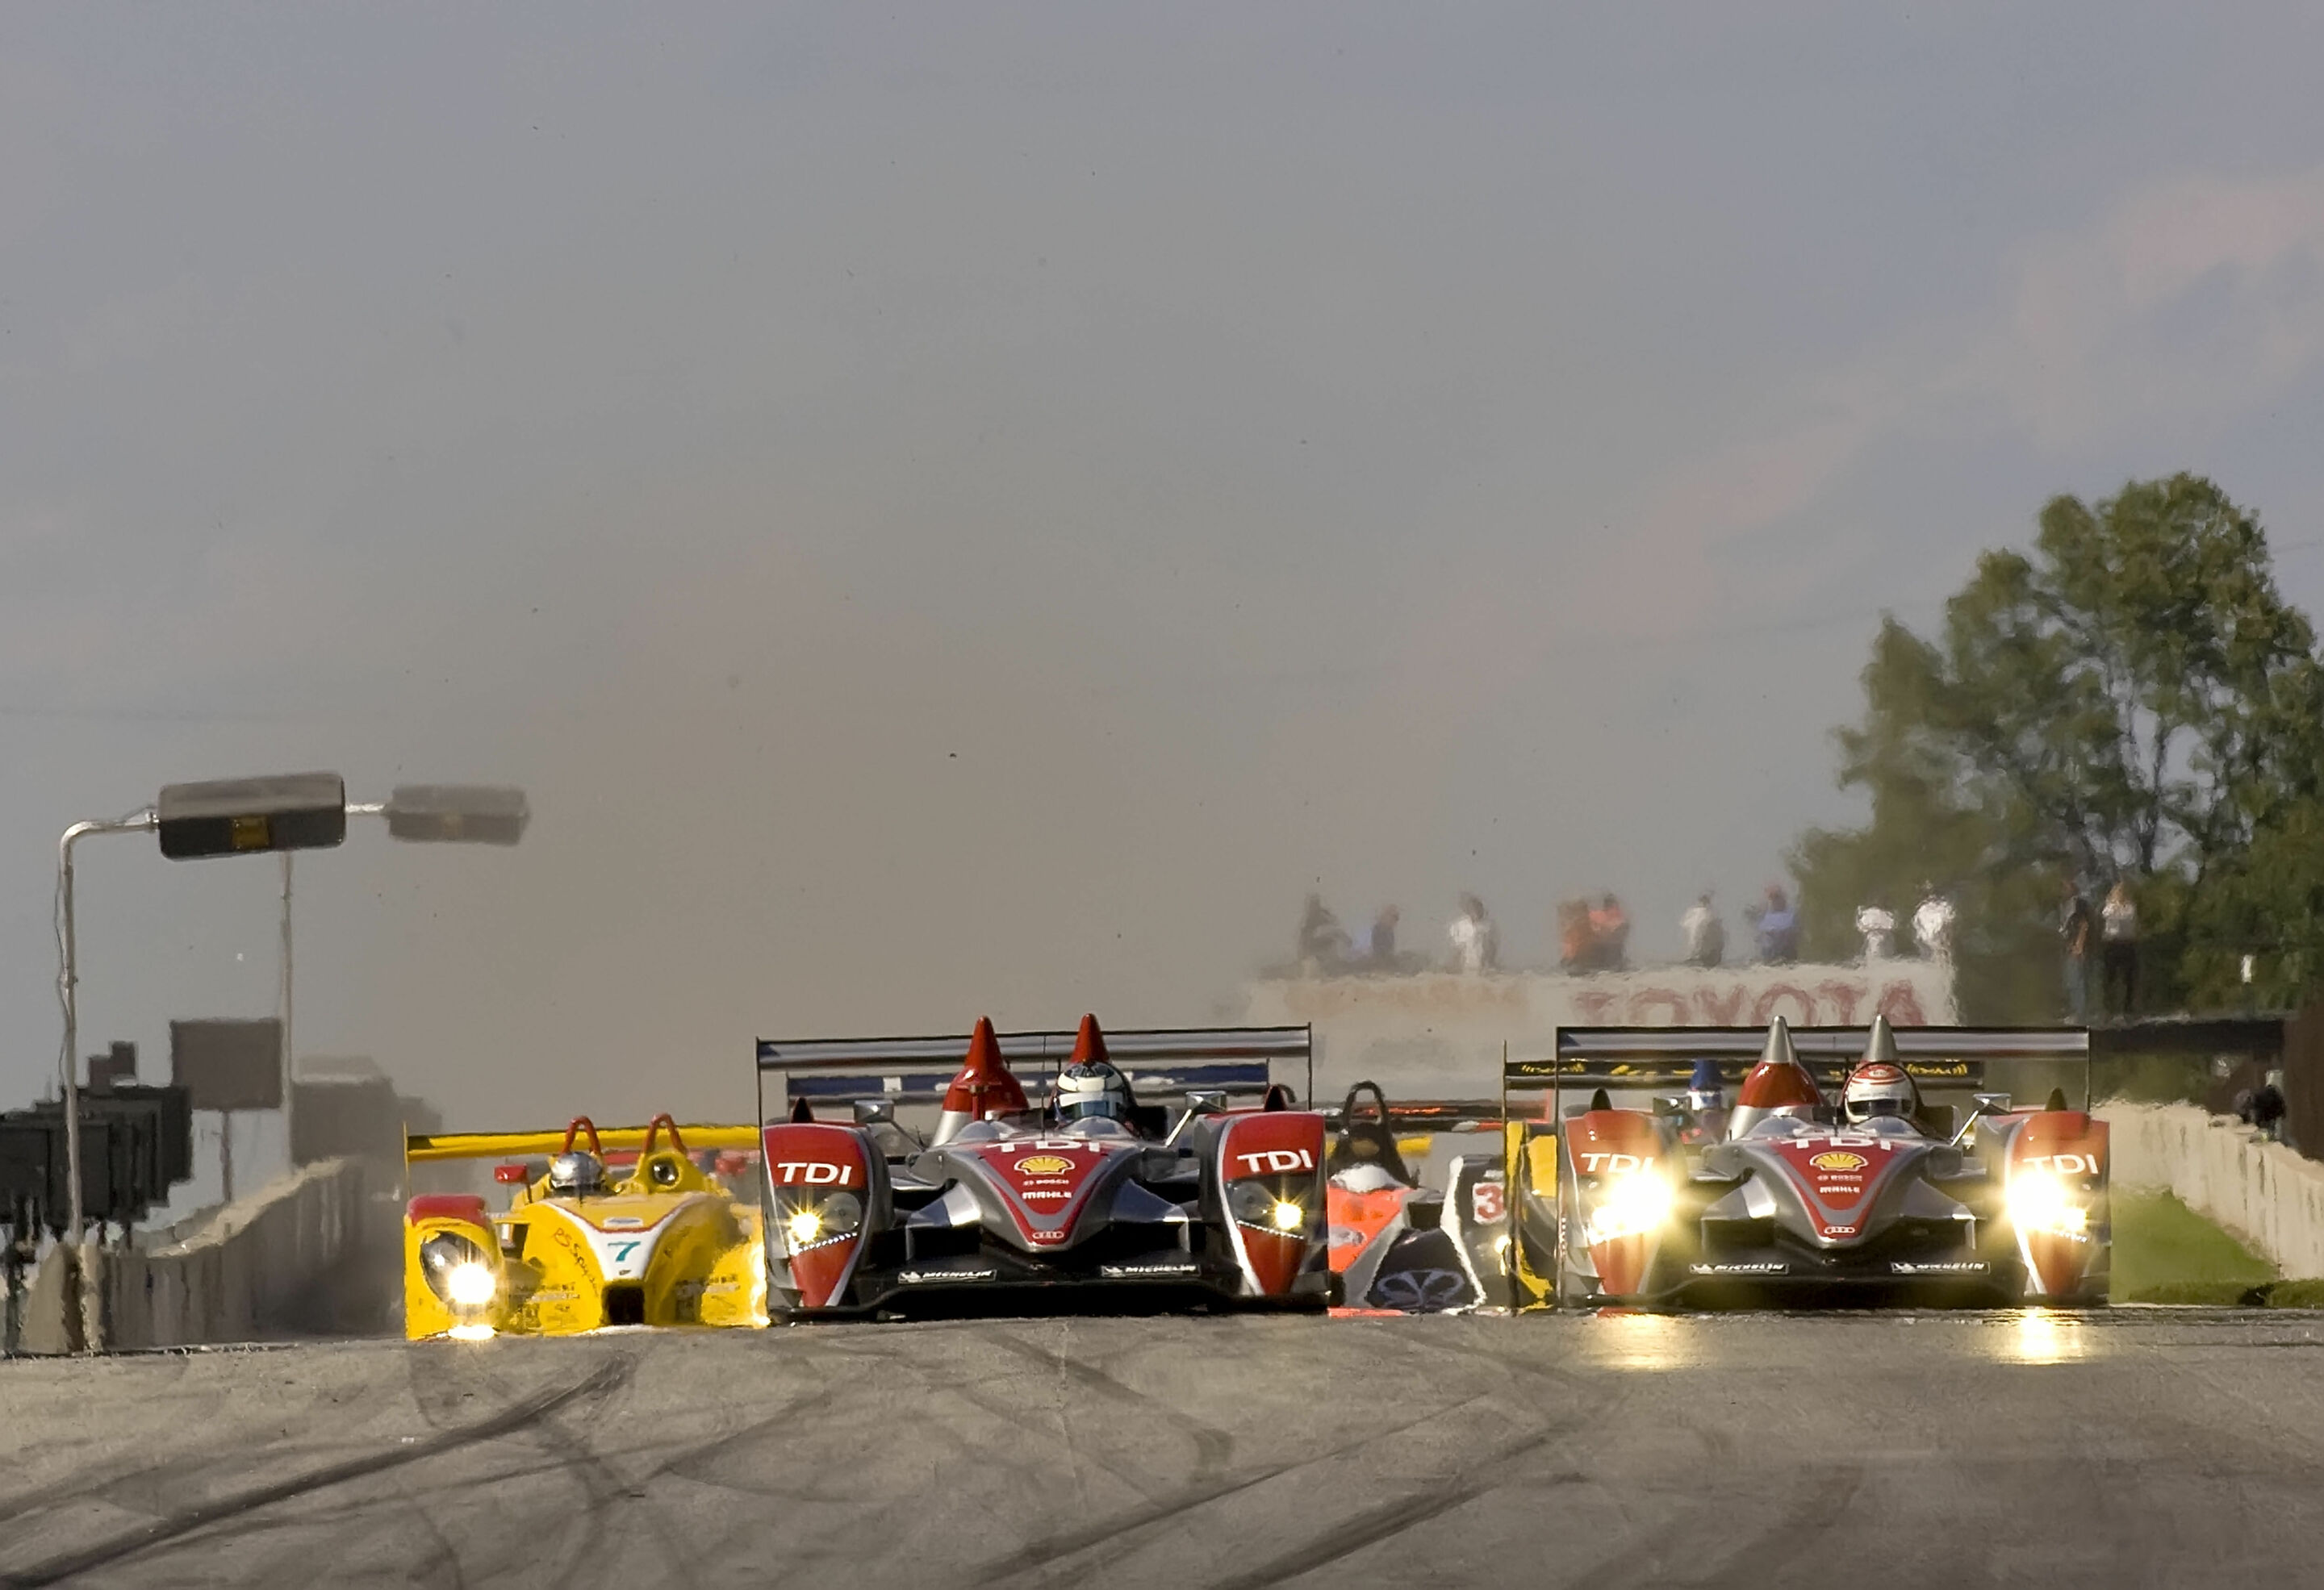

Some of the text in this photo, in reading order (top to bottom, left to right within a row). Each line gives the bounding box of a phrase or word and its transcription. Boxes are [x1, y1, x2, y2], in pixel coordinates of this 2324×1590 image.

[1574, 979, 1927, 1026] TOYOTA
[985, 1139, 1101, 1153] TDI
[1780, 1137, 1891, 1150] TDI
[1236, 1148, 1314, 1173] TDI
[1580, 1153, 1653, 1174] TDI
[2022, 1154, 2099, 1175] TDI
[777, 1162, 852, 1185] TDI
[1022, 1191, 1072, 1200] MAHLE
[608, 1241, 641, 1262] 7
